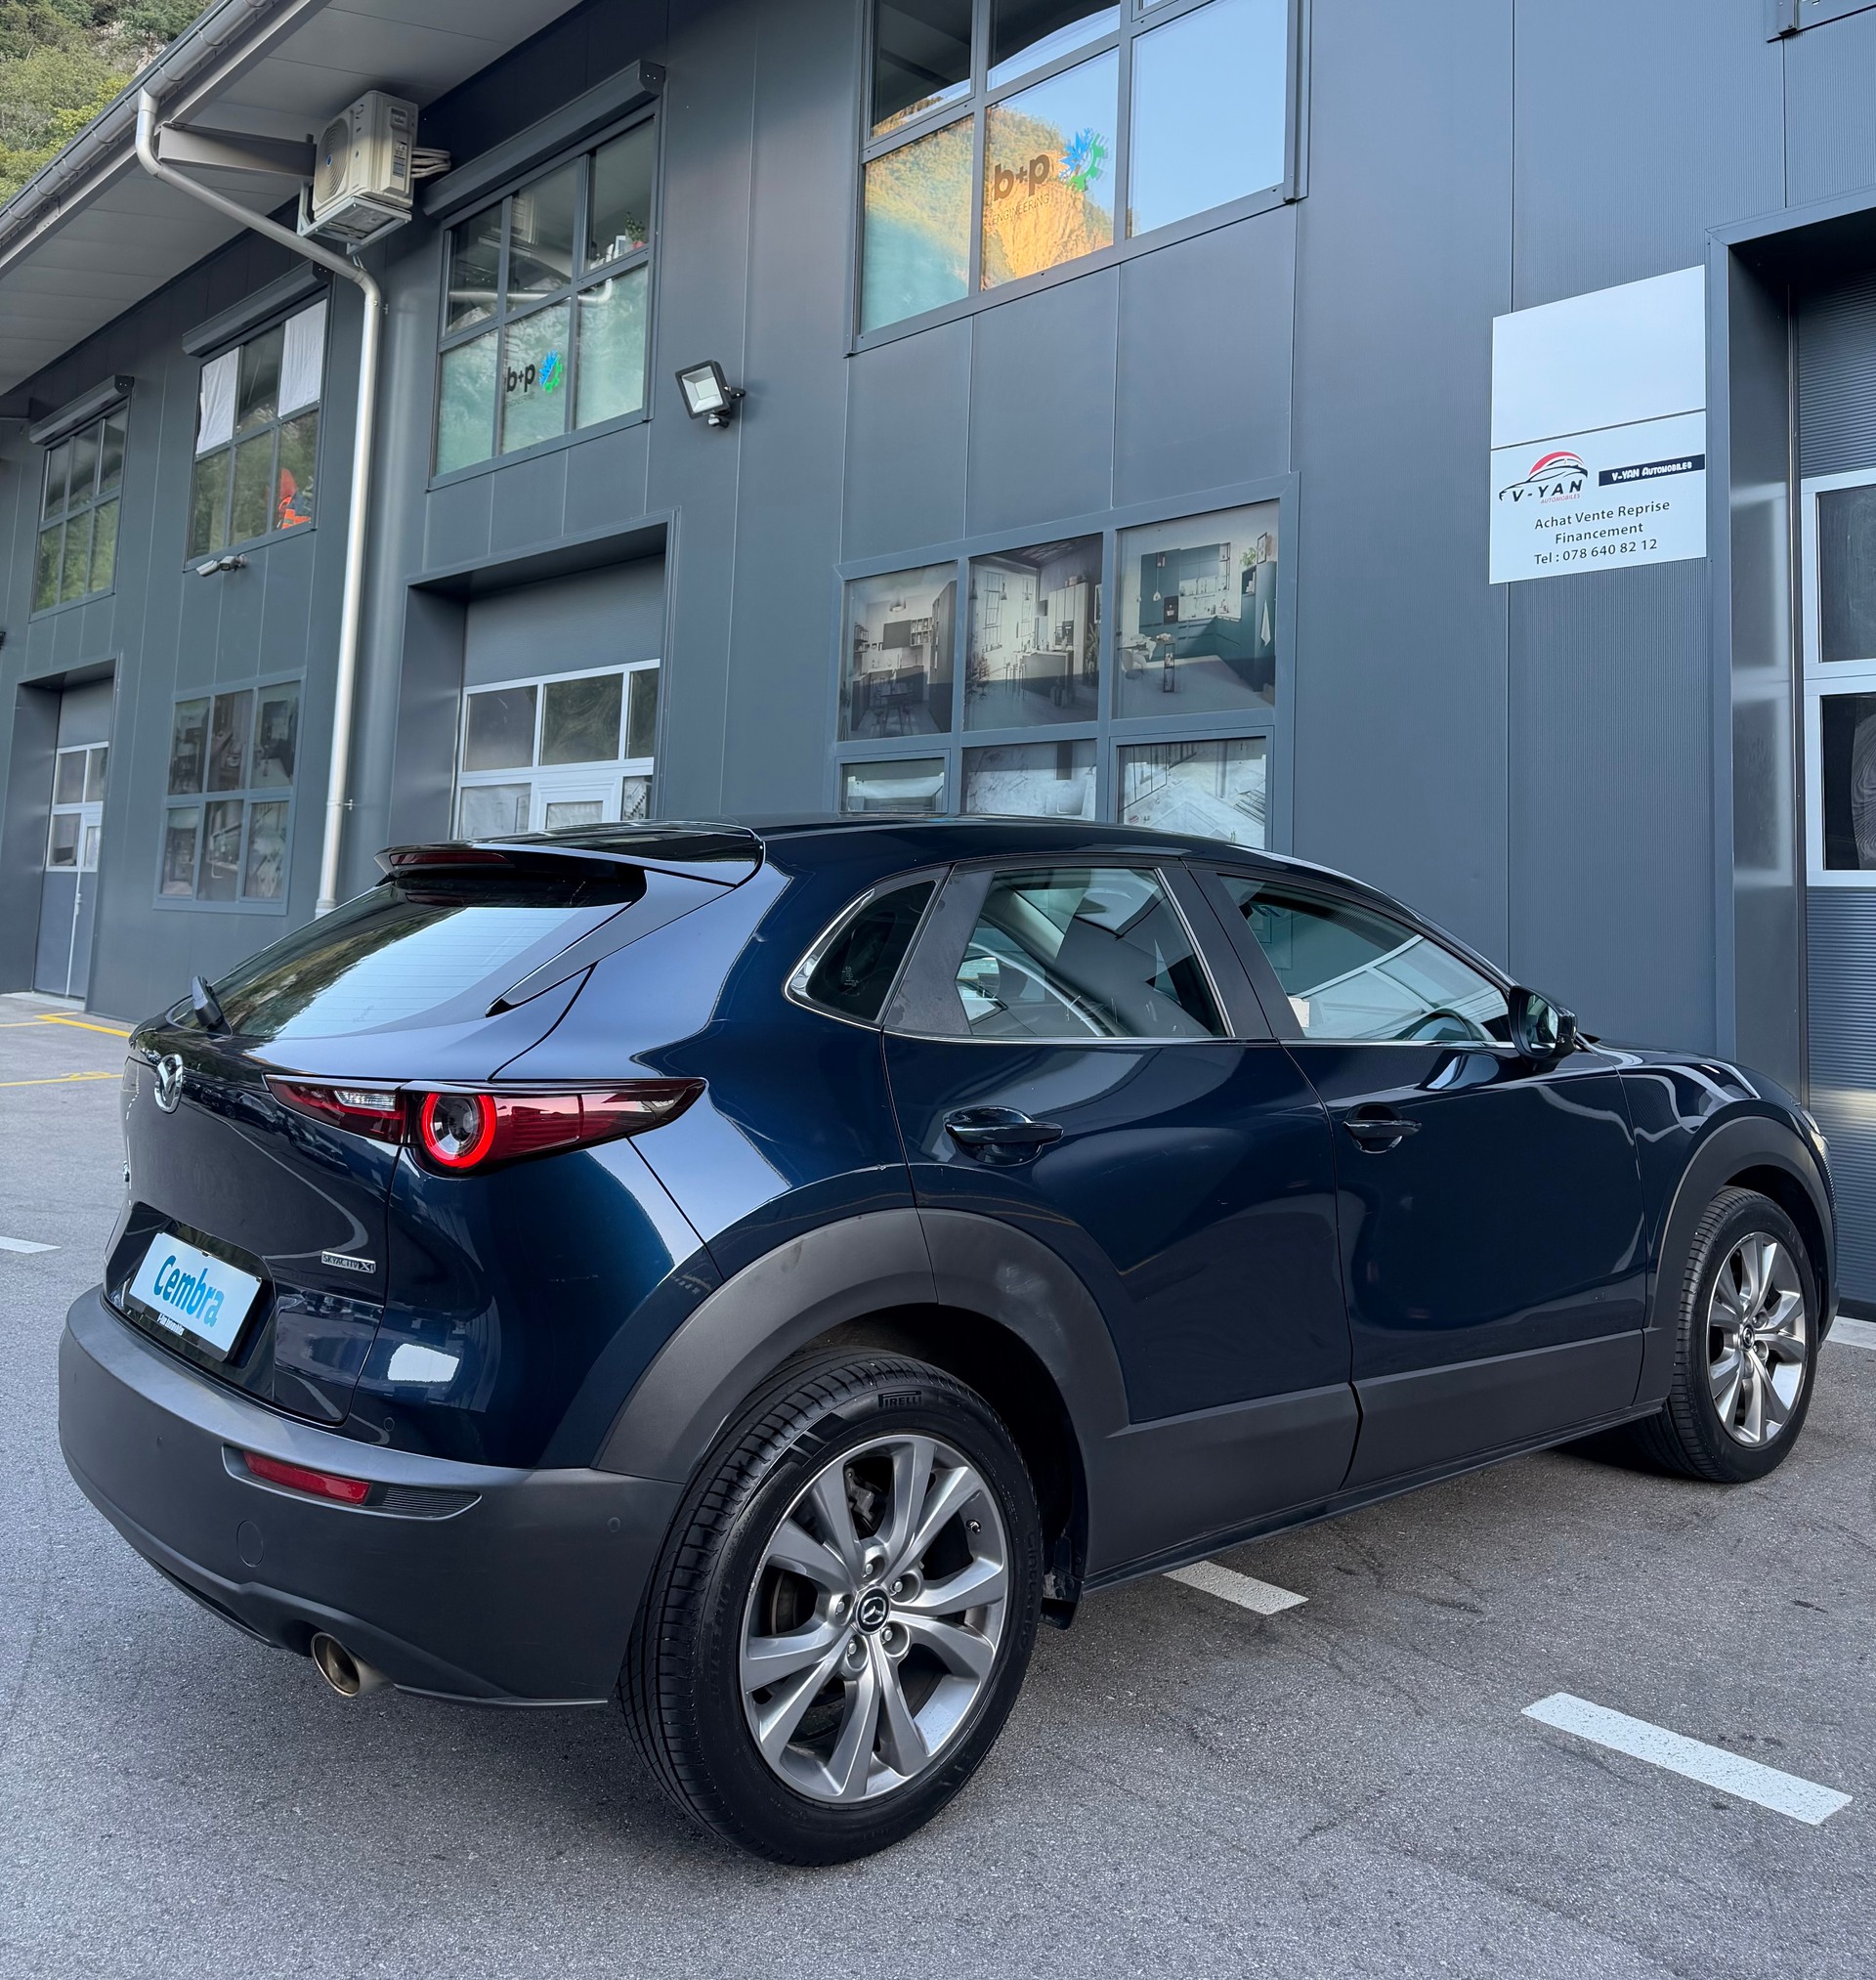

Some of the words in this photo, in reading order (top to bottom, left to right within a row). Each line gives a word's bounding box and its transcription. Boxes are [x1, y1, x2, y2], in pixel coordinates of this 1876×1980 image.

[993, 153, 1050, 202] b+p
[992, 194, 1050, 226] ENGINEERING
[506, 364, 535, 393] b+p
[1611, 468, 1641, 482] V-YAN
[1513, 479, 1583, 502] V-YAN
[1540, 493, 1581, 504] AUTOMOBILES
[1534, 513, 1572, 530] Achat
[1575, 508, 1614, 524] Vente
[1618, 500, 1671, 520] Reprise
[1556, 522, 1643, 544] Financement
[1562, 548, 1588, 561] 078
[1591, 543, 1616, 558] 640
[1620, 541, 1637, 553] 82
[1642, 538, 1658, 550] 12
[153, 1254, 226, 1328] Cembra
[877, 1390, 922, 1407] PIRELLI
